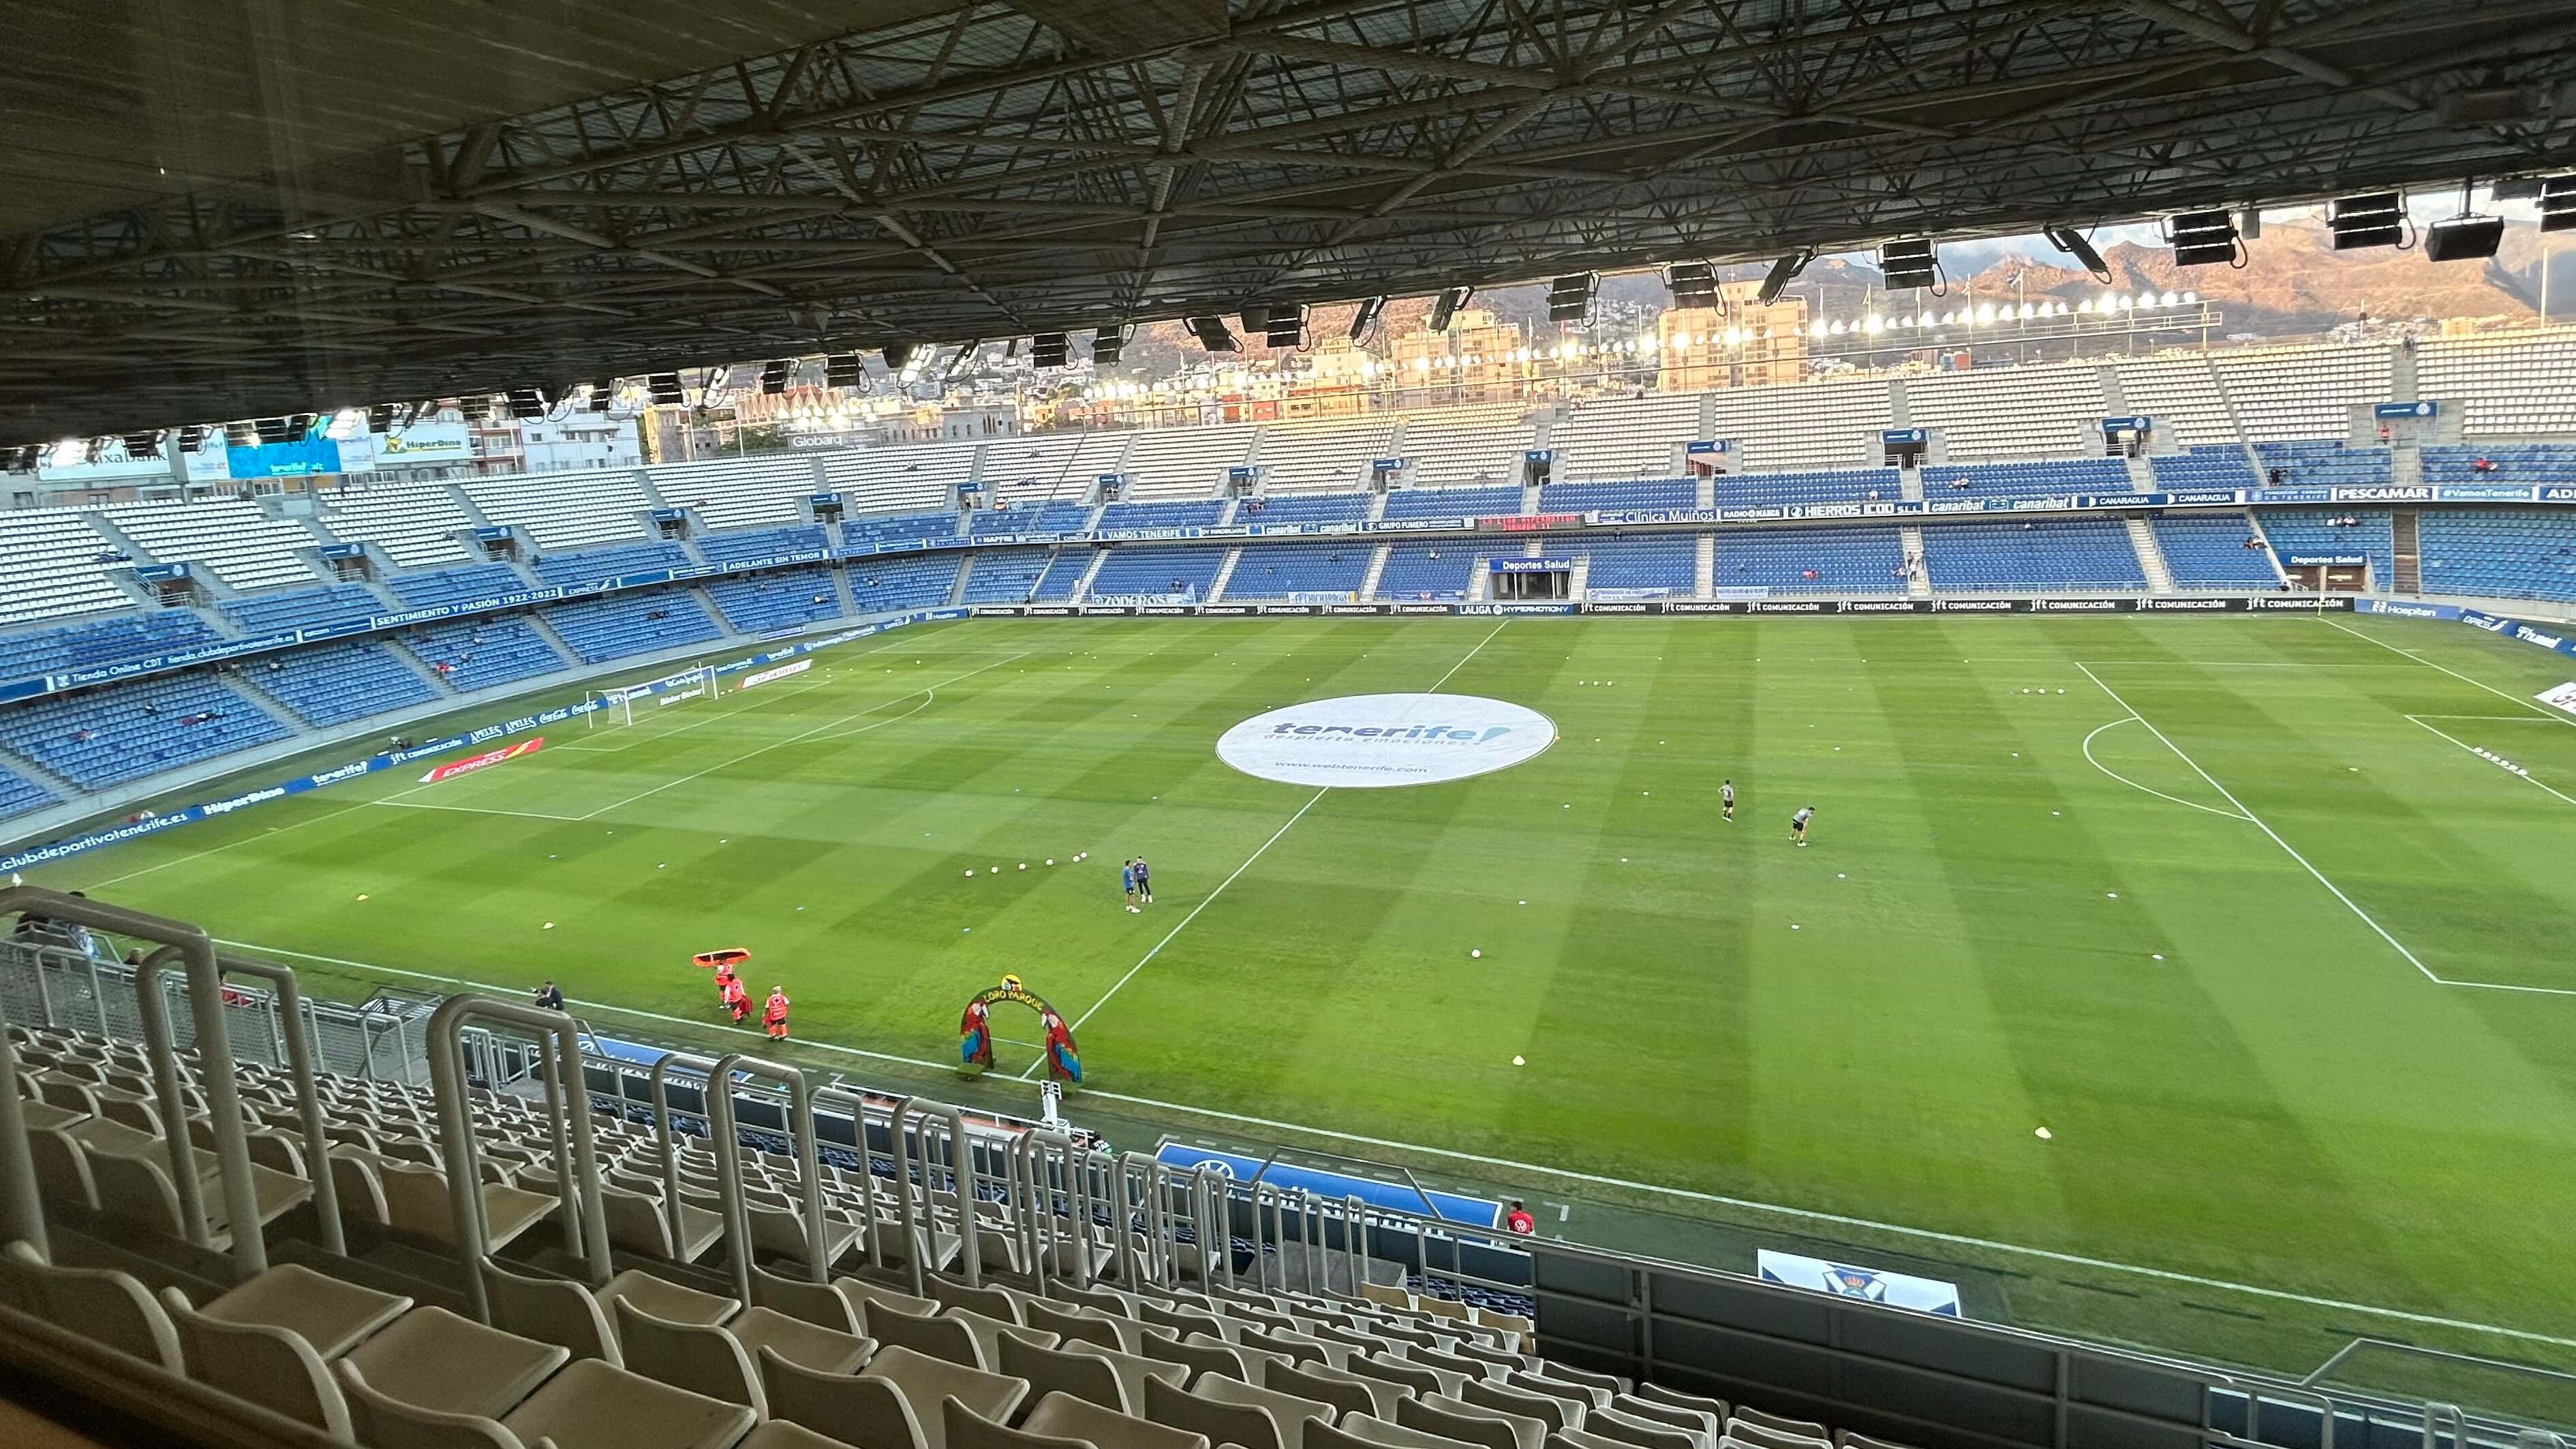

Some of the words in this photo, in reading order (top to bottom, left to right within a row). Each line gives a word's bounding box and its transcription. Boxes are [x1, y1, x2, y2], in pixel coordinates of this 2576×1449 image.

[406, 440, 461, 449] HiperDino
[793, 436, 842, 447] Globarq
[2178, 493, 2230, 502] CANARAGUA
[2339, 487, 2429, 499] PESCAMAR
[2546, 488, 2576, 498] AD
[1931, 500, 1985, 511] canaribat
[2012, 497, 2068, 509] canaribat
[2099, 497, 2149, 505] CANARAGUA
[1625, 510, 1668, 523] Clínica
[1669, 509, 1714, 522] Muiños
[1805, 504, 1861, 517] HIERROS
[1863, 503, 1895, 515] ICOD
[1266, 523, 1301, 534] canaribat
[1320, 523, 1357, 532] canaribat
[1401, 521, 1428, 530] FUMERO
[982, 535, 1014, 543] MAPFRE
[1107, 530, 1137, 538] VAMOS
[1137, 529, 1180, 538] TENERIFE
[729, 558, 773, 570] ADELANTE
[774, 555, 790, 564] SIN
[790, 552, 820, 562] TEMOR
[1503, 561, 1543, 572] Deportes
[1544, 560, 1570, 569] Salud
[2290, 555, 2333, 565] Deportes
[2335, 555, 2363, 564] Salud
[376, 606, 450, 626] SENTIMIENTO
[450, 605, 459, 613] Y
[461, 597, 500, 612] PASIÓN
[502, 589, 557, 605] 1922-2022
[1460, 605, 1492, 614] LALIGA
[1581, 602, 1593, 613] jft
[1594, 603, 1646, 612] COMUNICACIÓN
[1661, 601, 1674, 613] jft
[1675, 603, 1730, 611] COMUNICACIÓN
[1747, 601, 1761, 613] jft
[1762, 602, 1820, 611] COMUNICACIÓN
[1837, 600, 1852, 613] jft
[1853, 601, 1914, 611] COMUNICACIÓN
[1931, 600, 1947, 612] jft
[1948, 600, 2012, 610] COMUNICACIÓN
[2031, 599, 2047, 611] jft
[2048, 600, 2115, 609] COMUNICACIÓN
[2136, 598, 2153, 611] jft
[2154, 599, 2226, 609] COMUNICACIÓN
[2247, 598, 2265, 610] jft
[2267, 598, 2344, 608] COMUNICACIÓN
[72, 670, 108, 683] Tienda
[110, 663, 142, 675] Online
[143, 657, 163, 669] CDT
[505, 716, 538, 735] APELES
[470, 725, 503, 744] APELES
[443, 753, 508, 778] EXPRESS
[1276, 761, 1428, 773] www.webtenerife.com
[202, 787, 285, 816] HiperDino
[983, 990, 1007, 1003] LORO
[1008, 991, 1044, 1011] PARQUE
